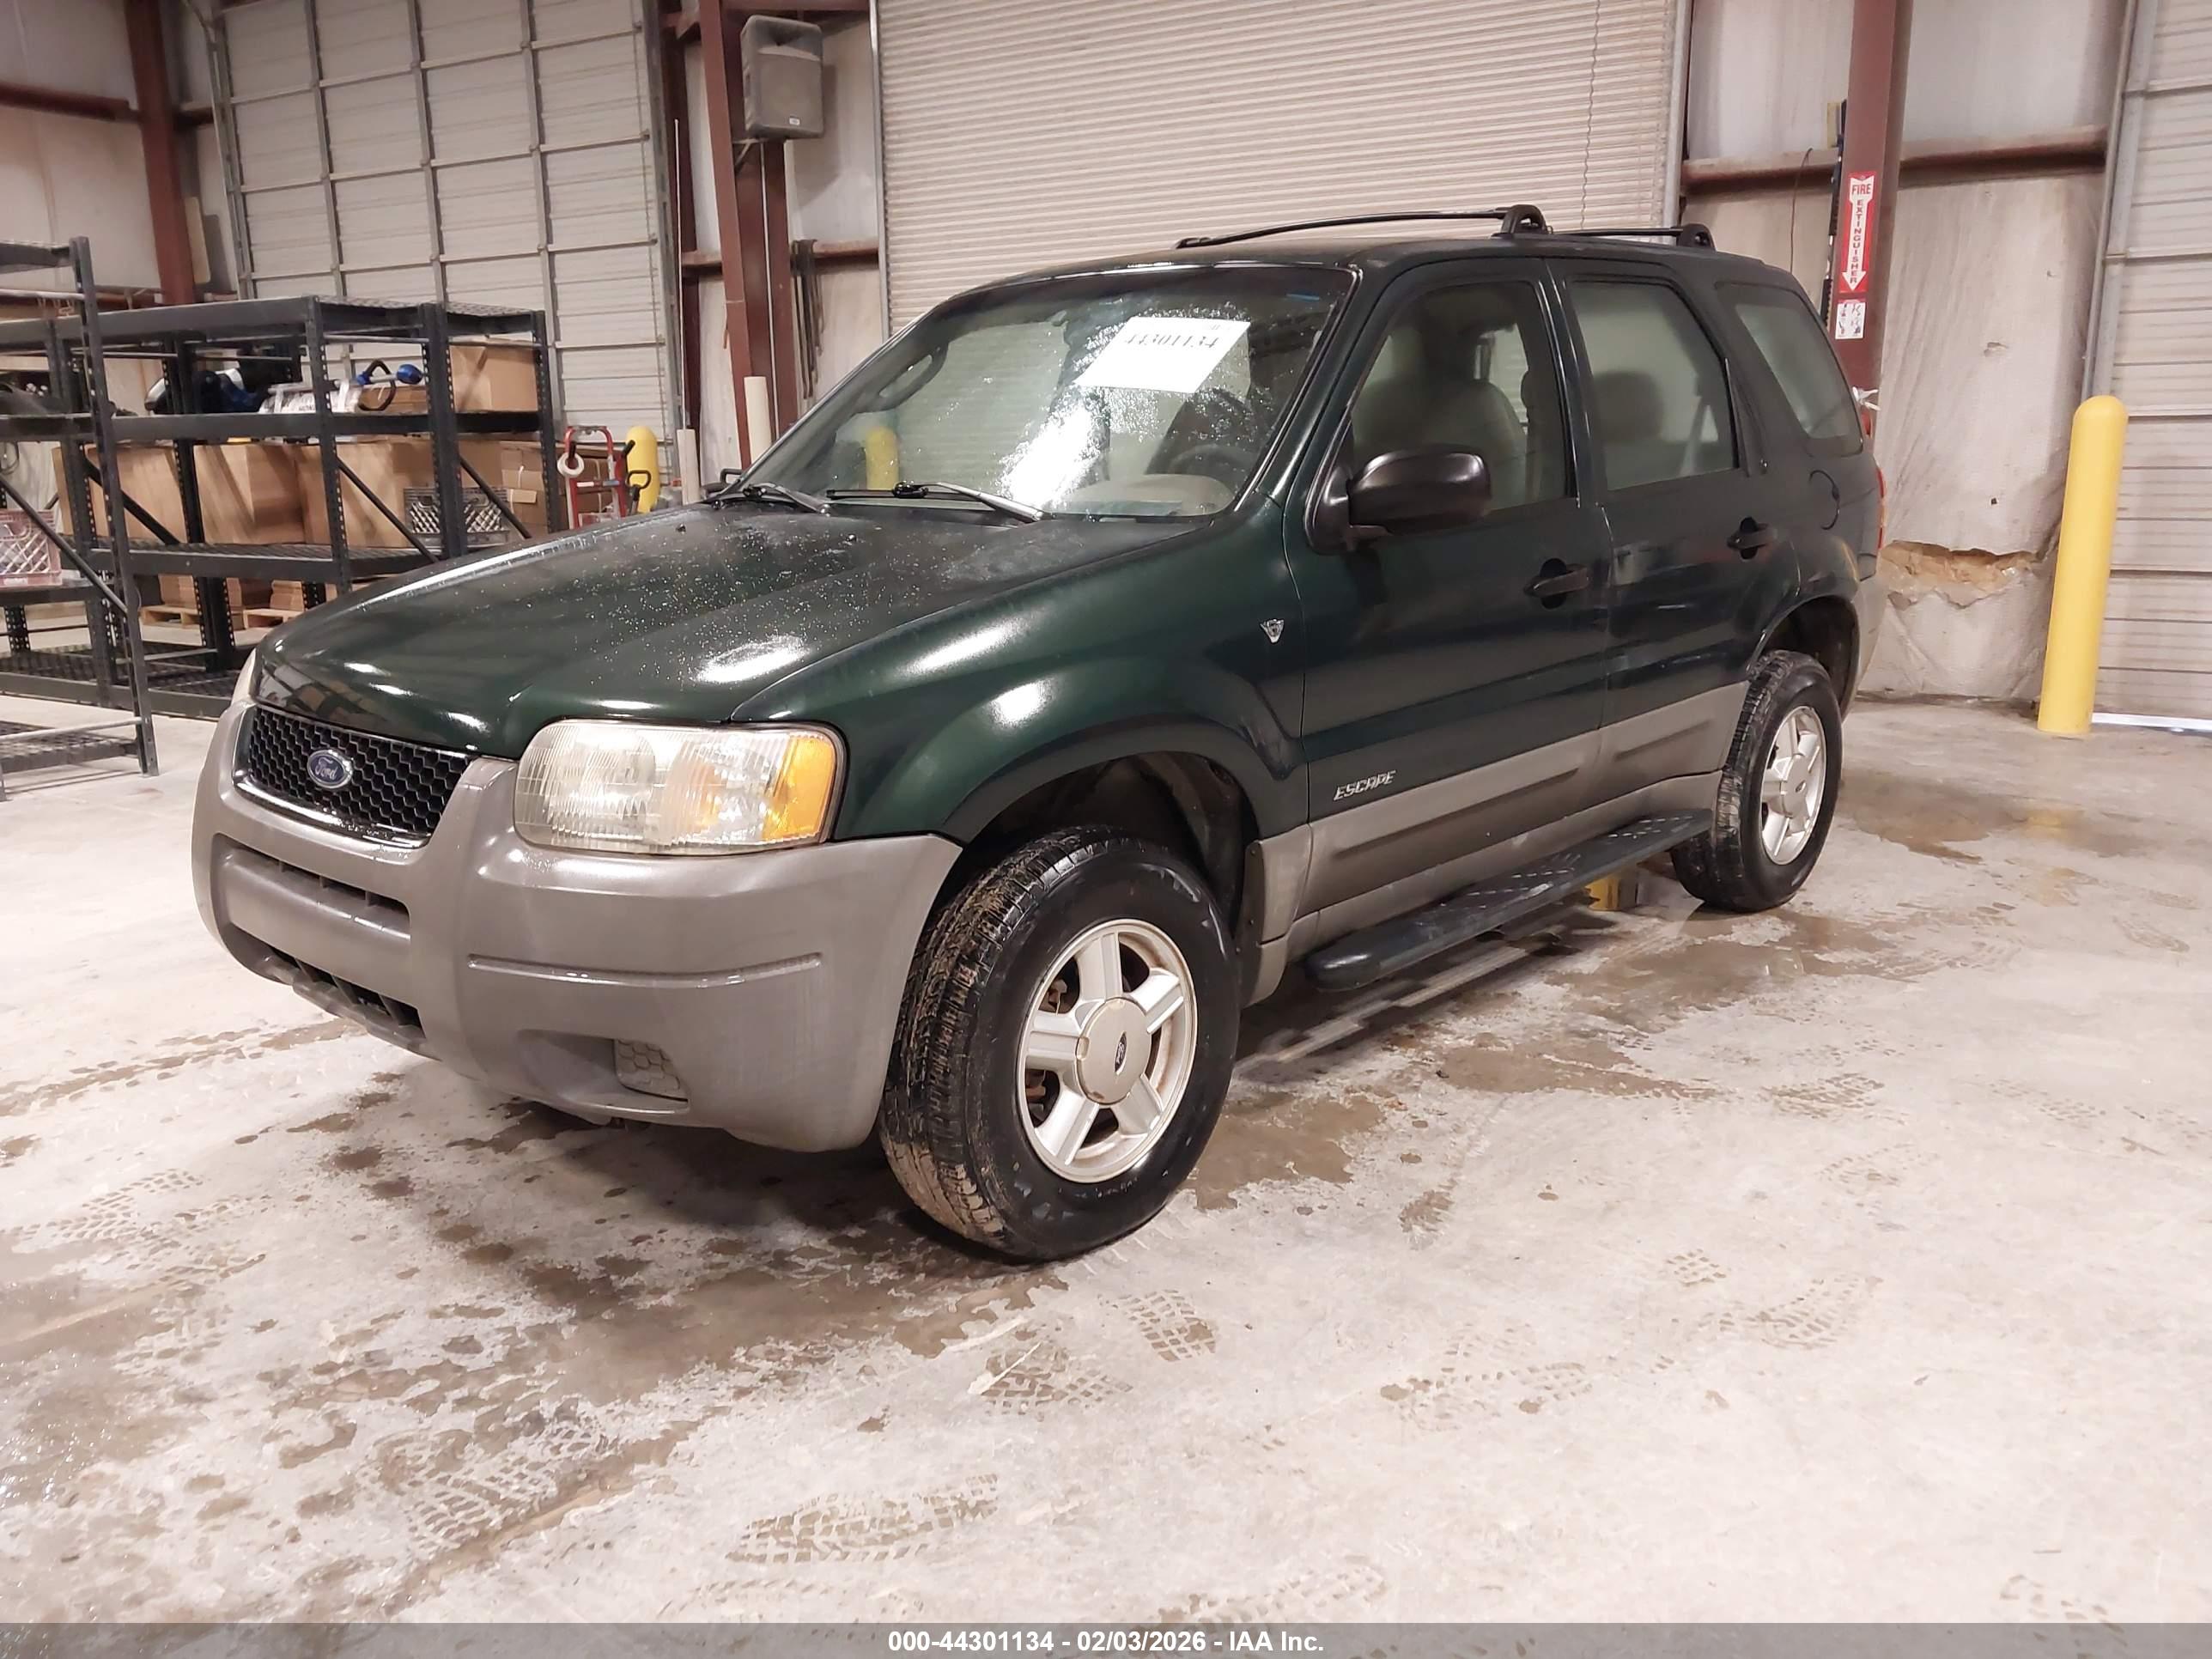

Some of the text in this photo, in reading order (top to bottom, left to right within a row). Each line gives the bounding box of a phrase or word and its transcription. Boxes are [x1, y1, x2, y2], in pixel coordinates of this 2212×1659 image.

[1851, 183, 1871, 195] FIRE
[1849, 198, 1864, 284] EXTINGUISHER
[314, 756, 338, 781] Ford
[1333, 769, 1397, 801] ESCAPE
